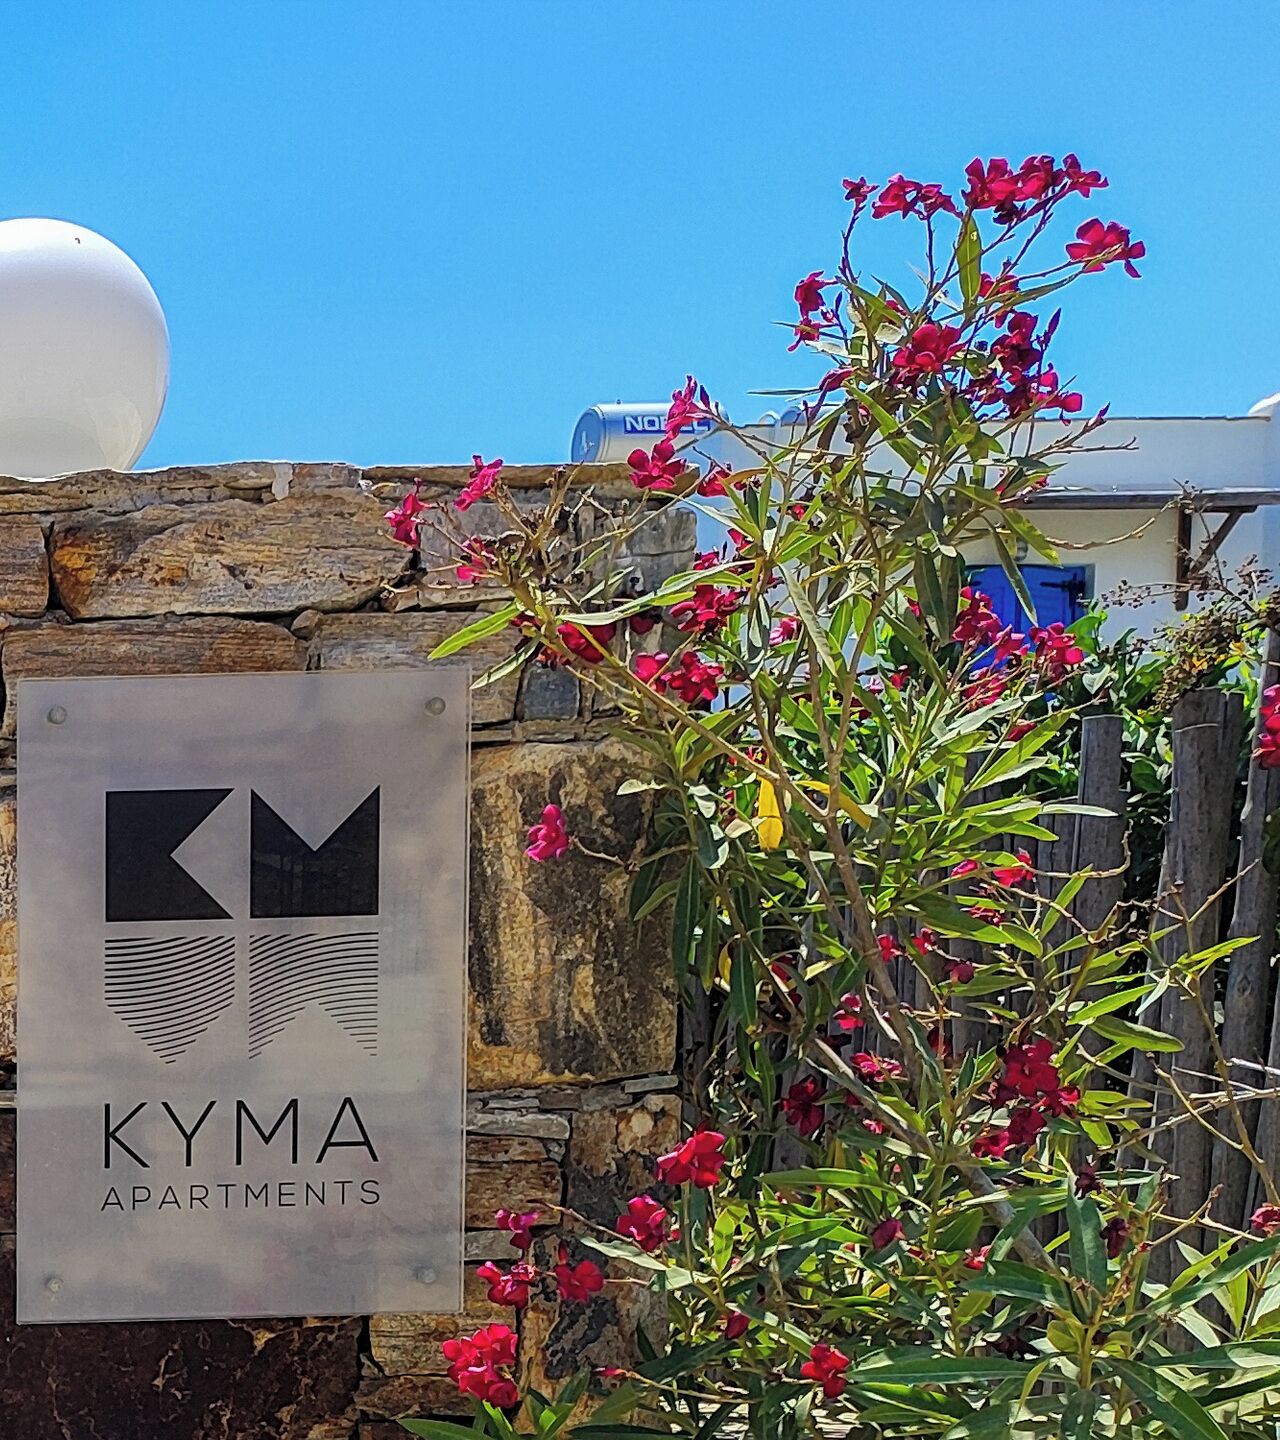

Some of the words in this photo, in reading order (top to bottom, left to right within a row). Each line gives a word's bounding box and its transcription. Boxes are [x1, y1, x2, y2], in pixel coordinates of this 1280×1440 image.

[624, 415, 709, 432] NOL
[104, 1096, 379, 1169] KYMA
[100, 1179, 380, 1212] APARTMENTS
